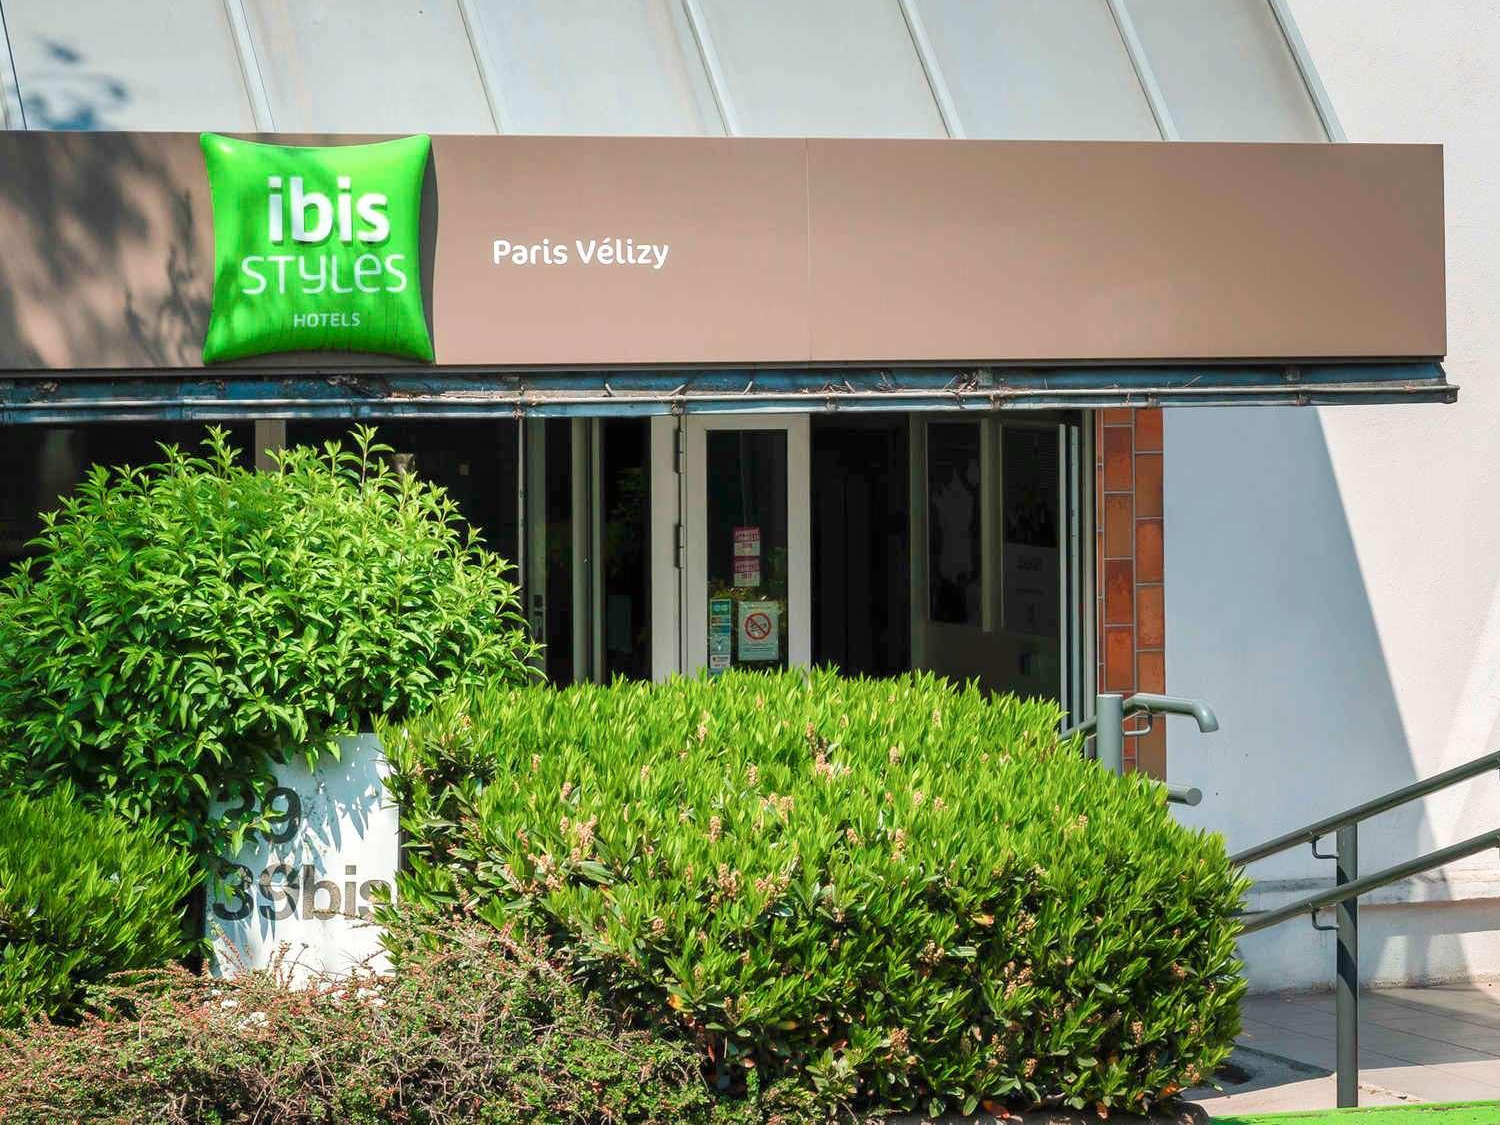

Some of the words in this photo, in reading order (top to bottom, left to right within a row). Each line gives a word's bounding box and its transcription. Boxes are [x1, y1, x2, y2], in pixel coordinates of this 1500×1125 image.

[267, 176, 390, 243] ibis
[493, 238, 569, 265] Paris
[575, 238, 669, 269] Vélizy
[294, 312, 360, 328] HOTELS
